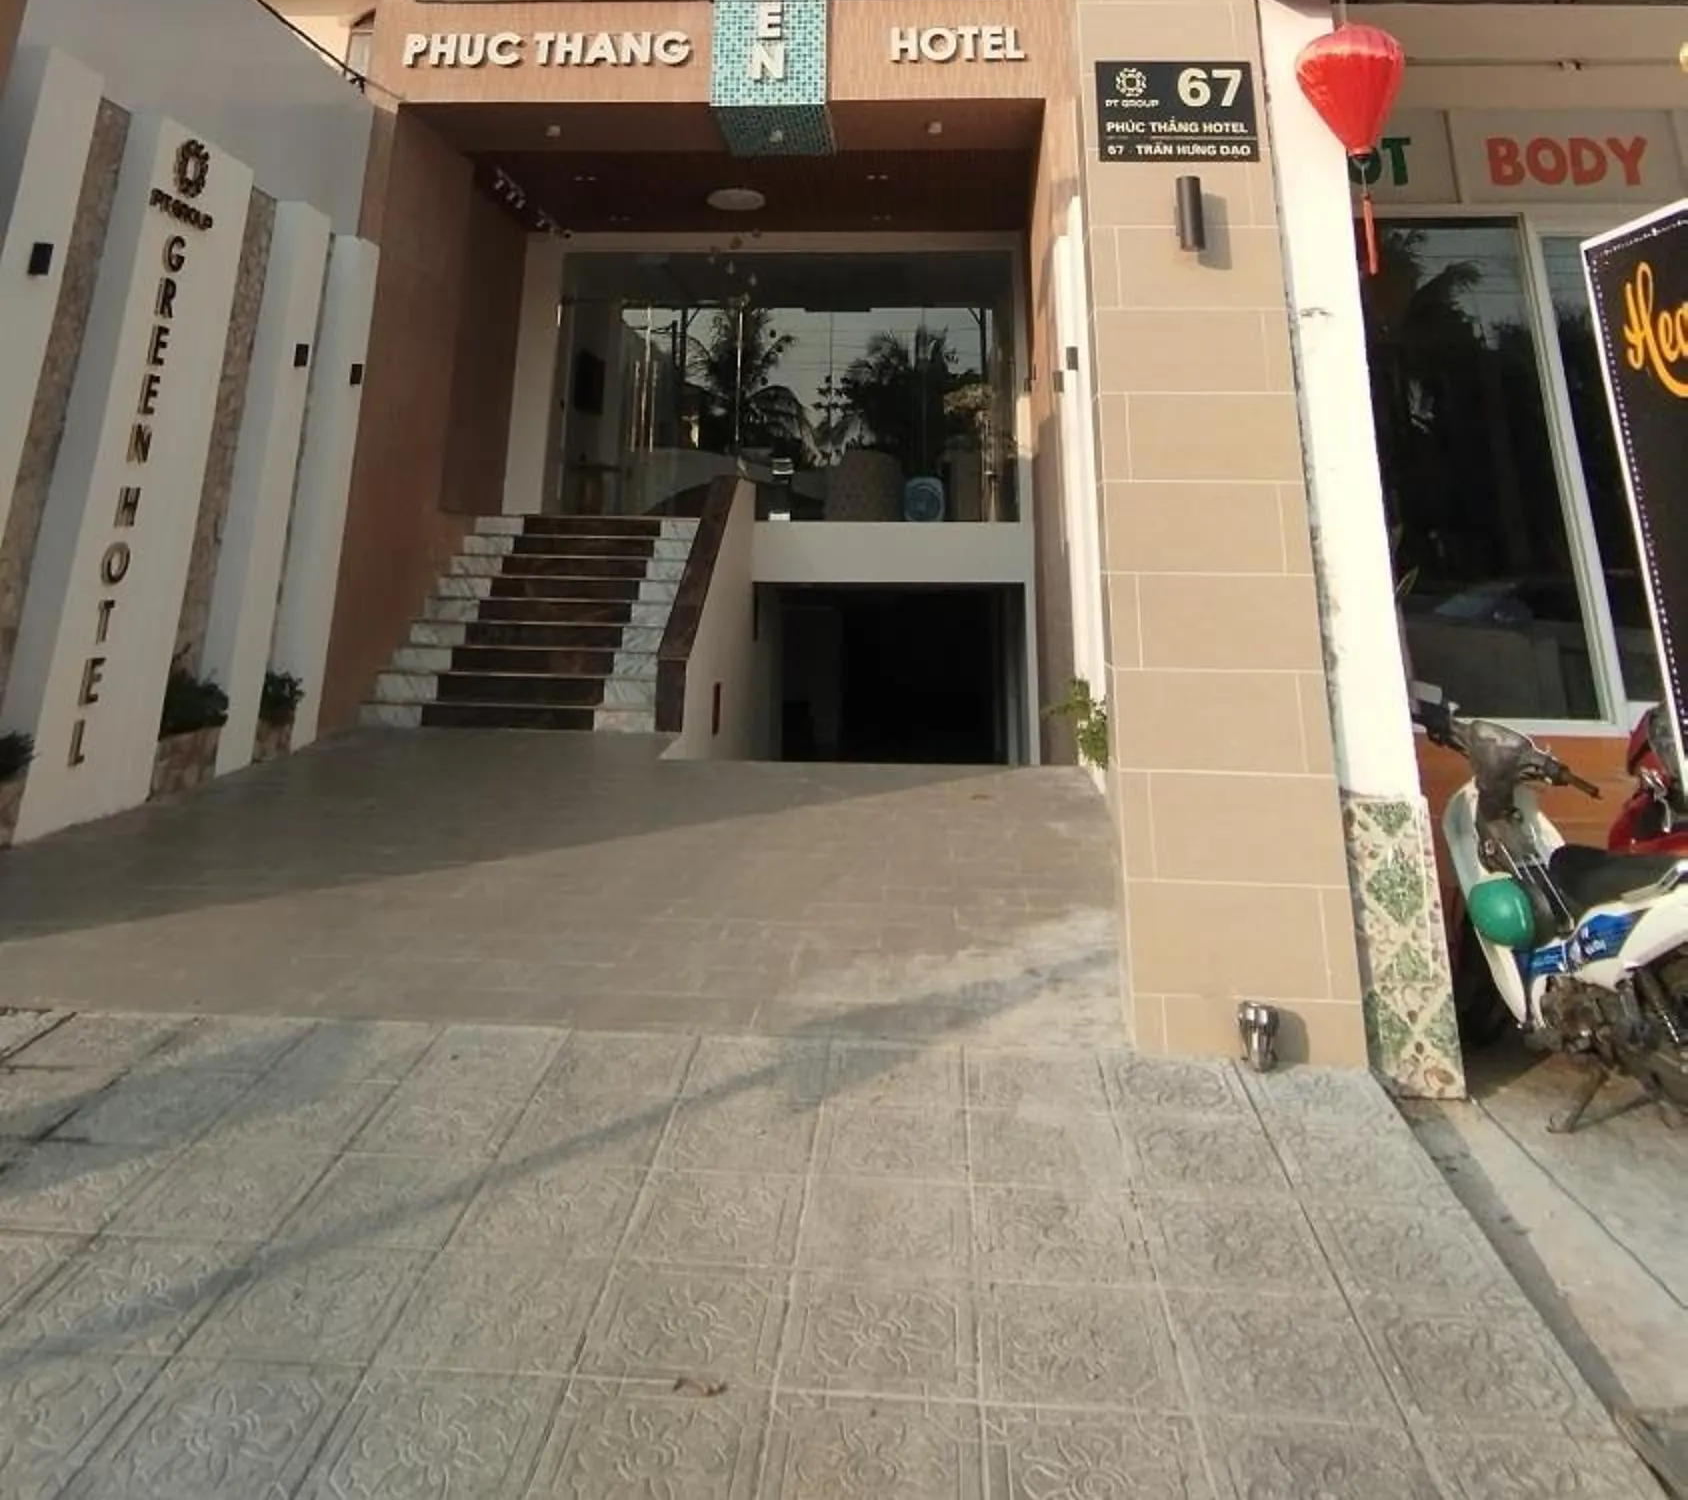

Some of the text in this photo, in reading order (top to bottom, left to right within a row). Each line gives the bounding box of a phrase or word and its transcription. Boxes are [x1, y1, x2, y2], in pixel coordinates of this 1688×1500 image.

[403, 30, 692, 68] PHUC THANG
[890, 25, 1026, 62] HOTEL
[1105, 99, 1160, 108] PT GROUP
[1177, 67, 1243, 108] 67
[1105, 119, 1146, 133] PHÚC
[1203, 121, 1249, 133] HOTEL
[1107, 144, 1125, 156] 67
[1487, 134, 1649, 187] BODY
[126, 234, 188, 464] GREEN
[66, 486, 142, 768] HOTEL
